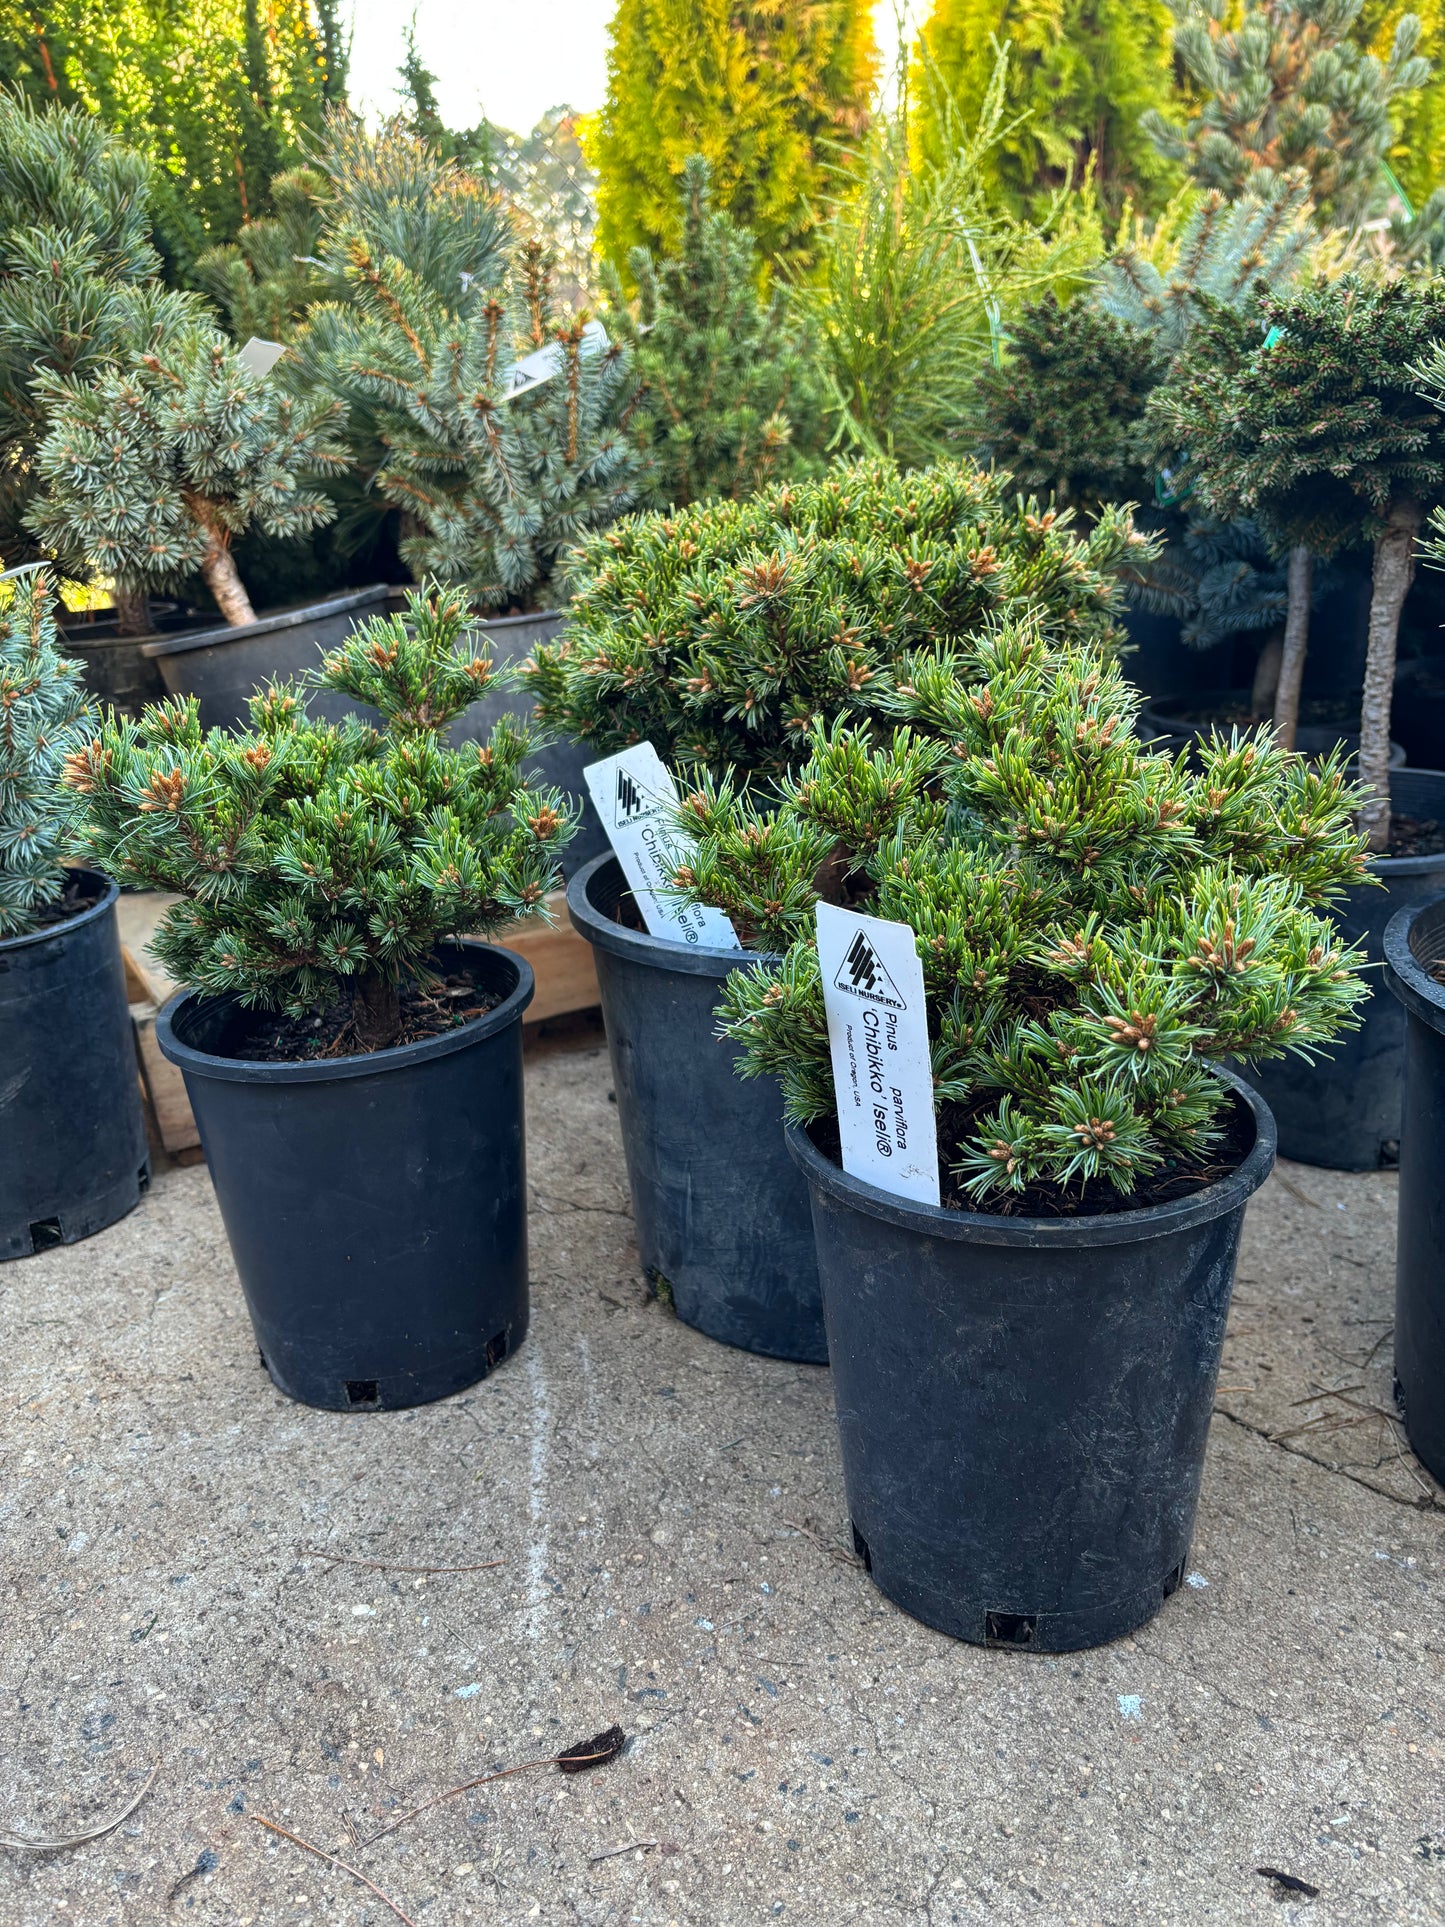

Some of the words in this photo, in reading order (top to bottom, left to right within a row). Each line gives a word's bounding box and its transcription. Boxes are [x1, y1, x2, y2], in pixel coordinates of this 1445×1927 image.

[837, 981, 858, 995] ISELI
[845, 1023, 855, 1053] Product
[884, 1011, 898, 1051] Pinus
[848, 1052, 857, 1062] of
[853, 1091, 862, 1107] USA
[872, 1102, 893, 1158] Iseli®
[889, 1086, 909, 1150] parviflora
